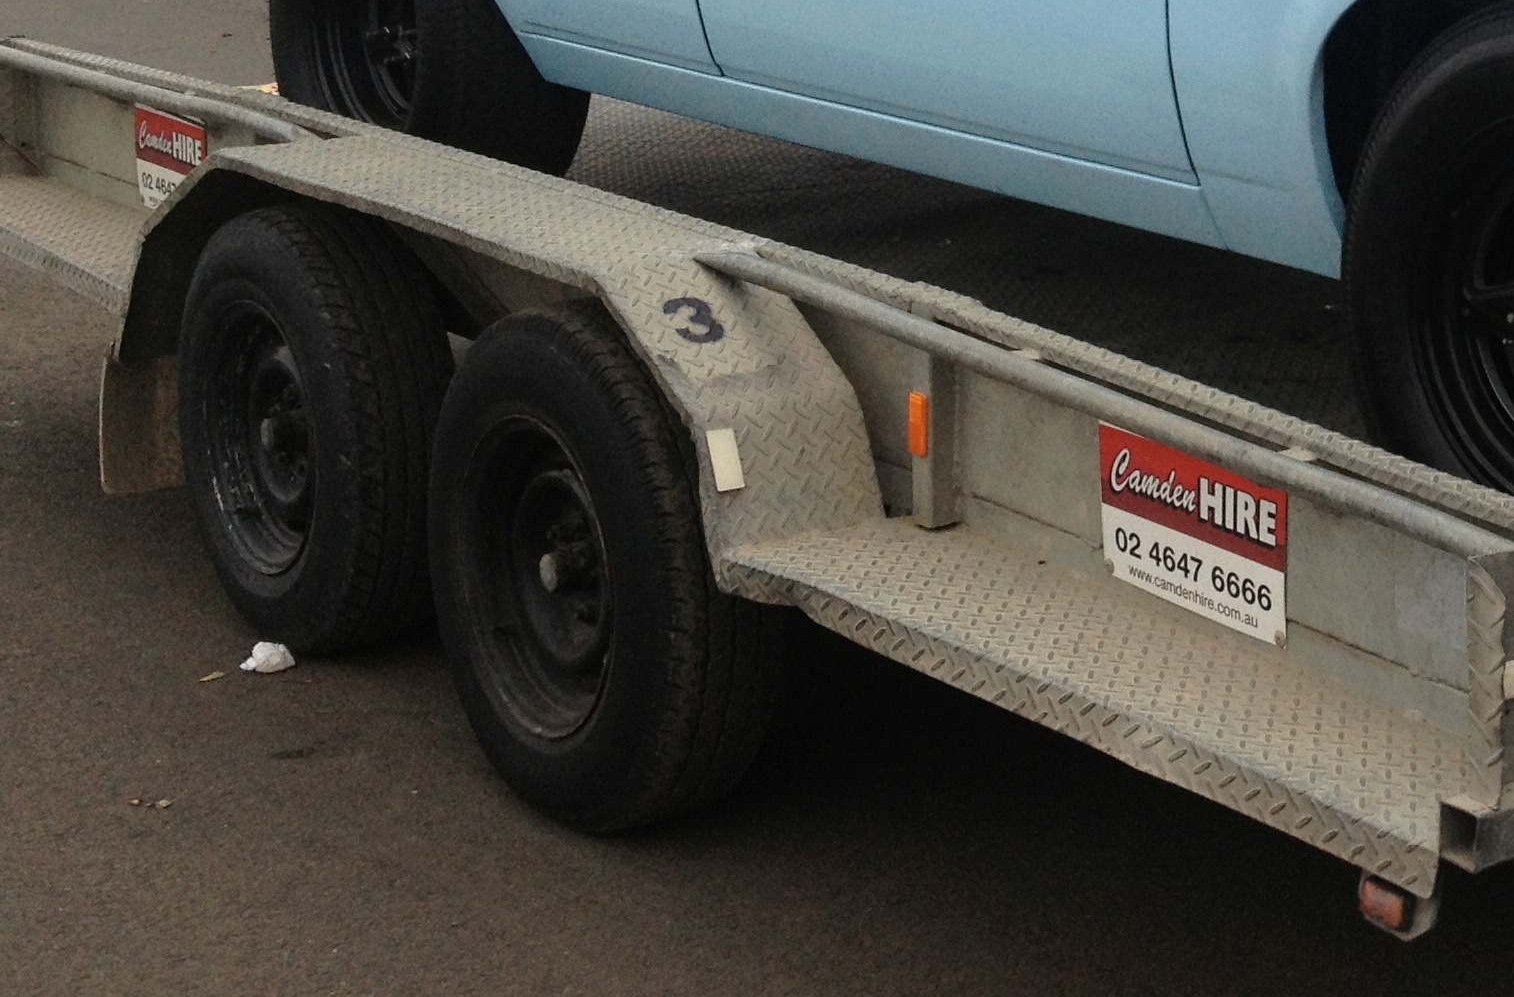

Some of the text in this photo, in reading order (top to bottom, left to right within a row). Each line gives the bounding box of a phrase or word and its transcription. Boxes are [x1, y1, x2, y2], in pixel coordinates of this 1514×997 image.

[172, 131, 203, 166] HIRE
[141, 172, 154, 190] 02
[662, 296, 725, 344] 3
[1110, 447, 1278, 547] Camden HIRE
[1115, 527, 1272, 612] 02 4647 6666
[1128, 564, 1259, 629] www.camdenhire.com.au
